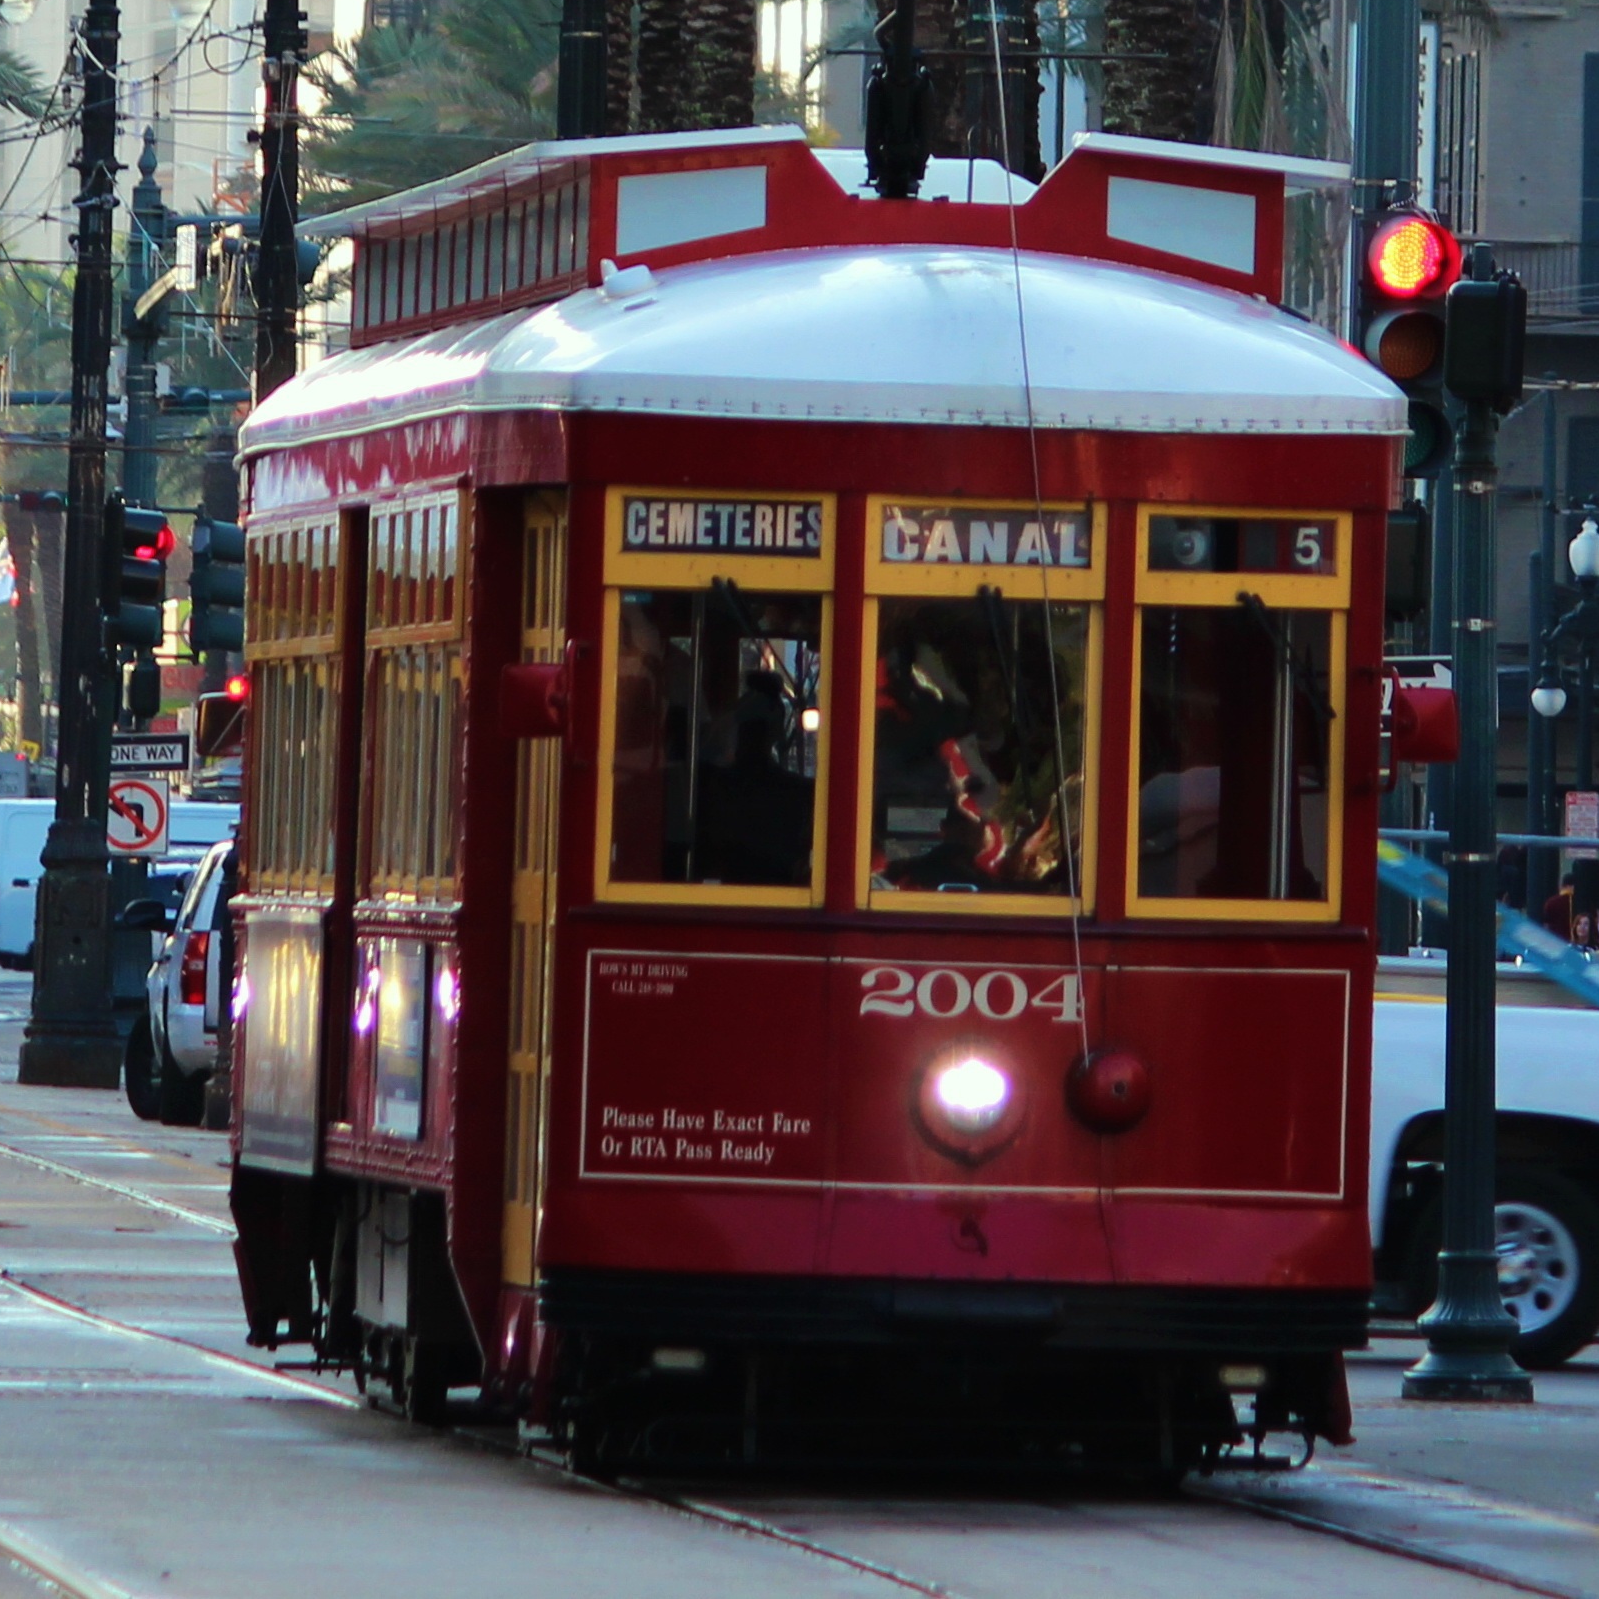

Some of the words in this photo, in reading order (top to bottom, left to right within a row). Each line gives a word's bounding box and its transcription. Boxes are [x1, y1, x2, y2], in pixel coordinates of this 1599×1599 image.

[626, 500, 822, 550] CEMETERIES
[883, 518, 1089, 566] CANAL
[1294, 527, 1321, 565] 5
[110, 746, 141, 761] ONE
[146, 746, 177, 761] WAY
[860, 966, 1085, 1022] 2004
[602, 1106, 654, 1129] Please
[662, 1108, 705, 1130] Have
[712, 1109, 764, 1132] Exact
[772, 1112, 811, 1133] Fare
[601, 1135, 623, 1156] Or
[630, 1136, 667, 1158] RTA
[675, 1138, 712, 1159] Pass
[720, 1139, 775, 1166] Ready
